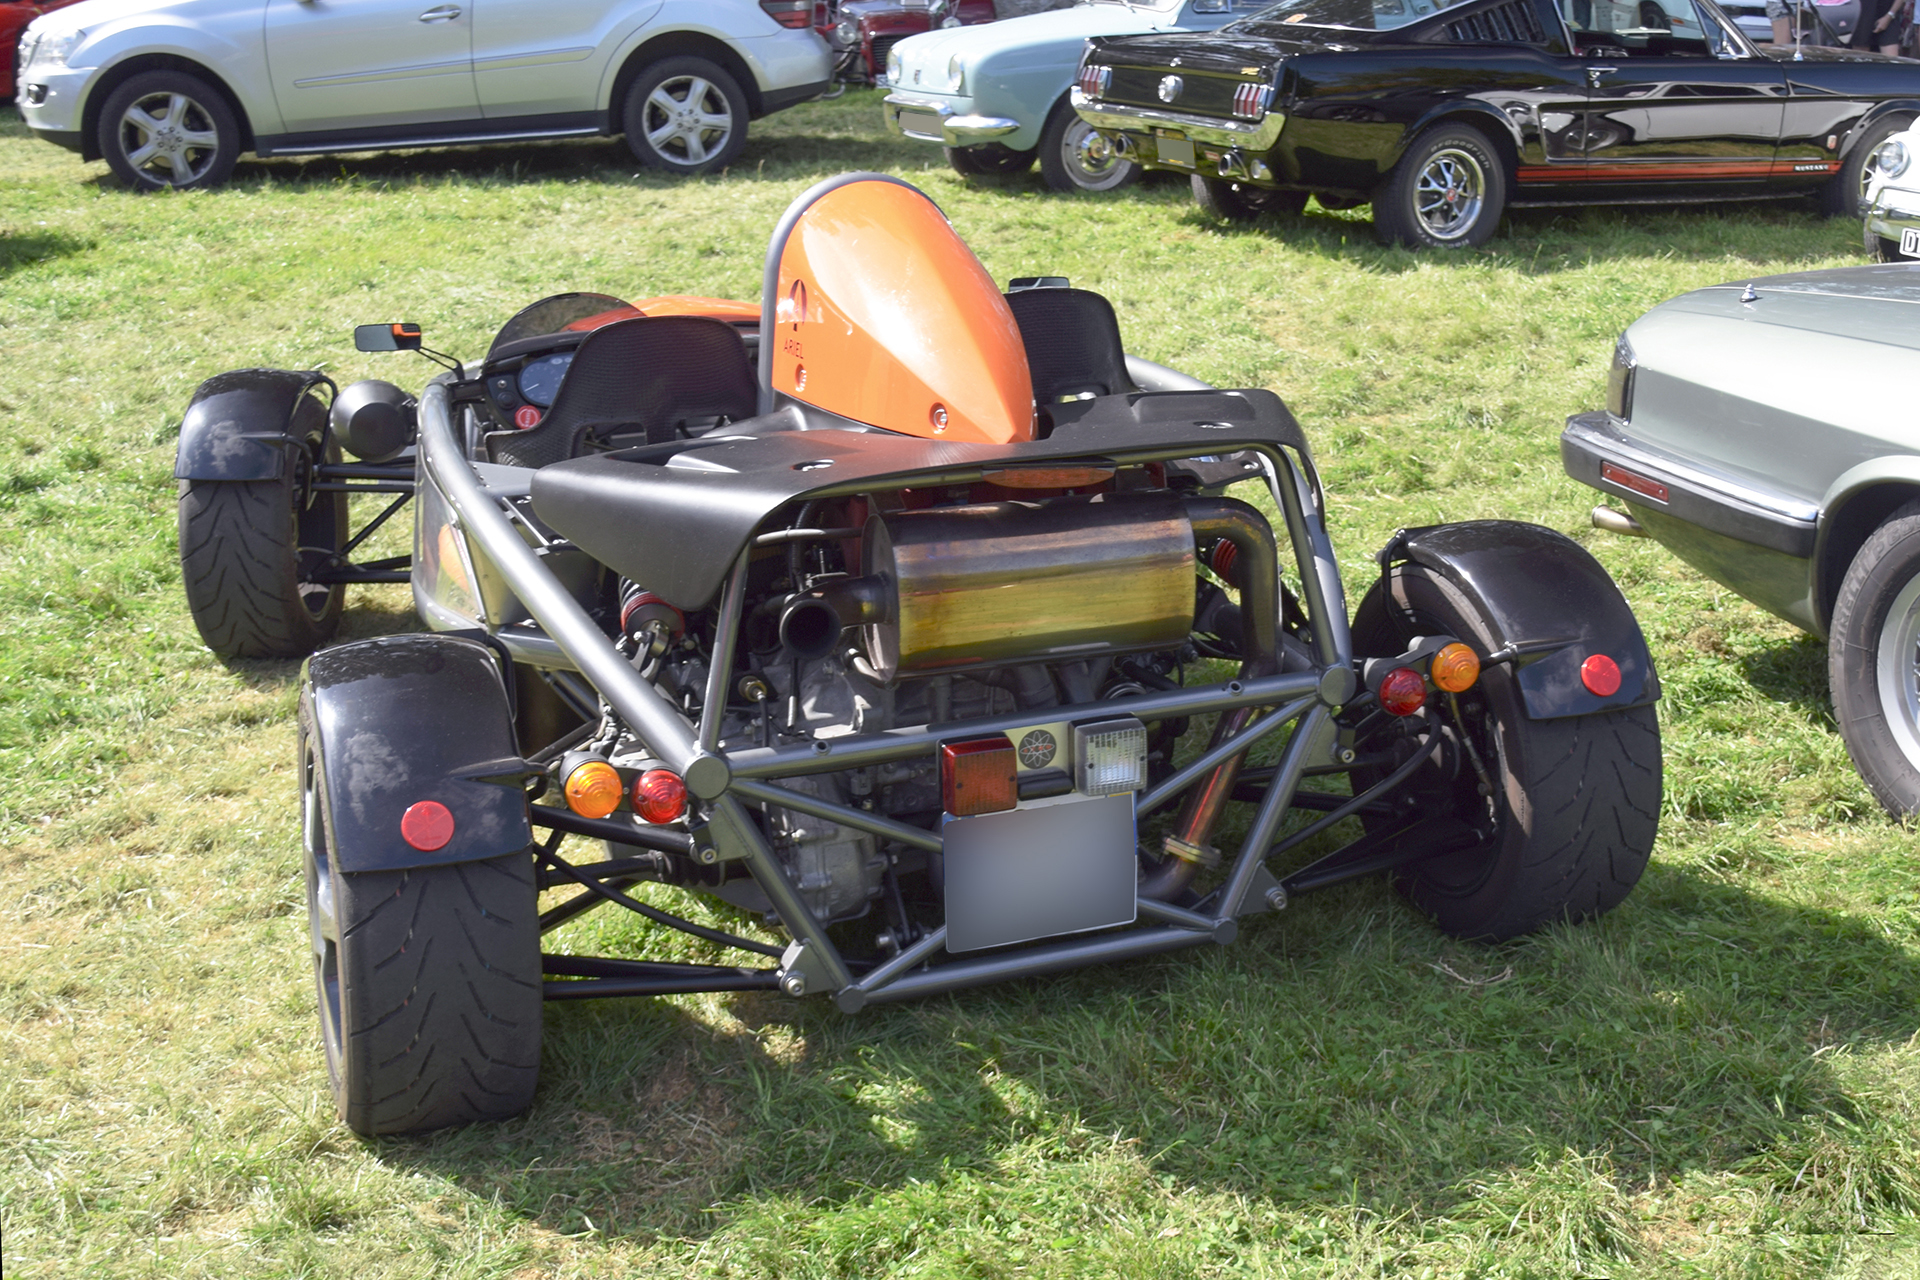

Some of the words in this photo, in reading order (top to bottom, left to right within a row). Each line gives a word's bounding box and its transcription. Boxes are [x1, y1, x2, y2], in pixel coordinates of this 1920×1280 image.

[1794, 164, 1829, 172] MUSTANG
[783, 337, 804, 360] ARIEL
[1835, 557, 1871, 656] PIRELLI
